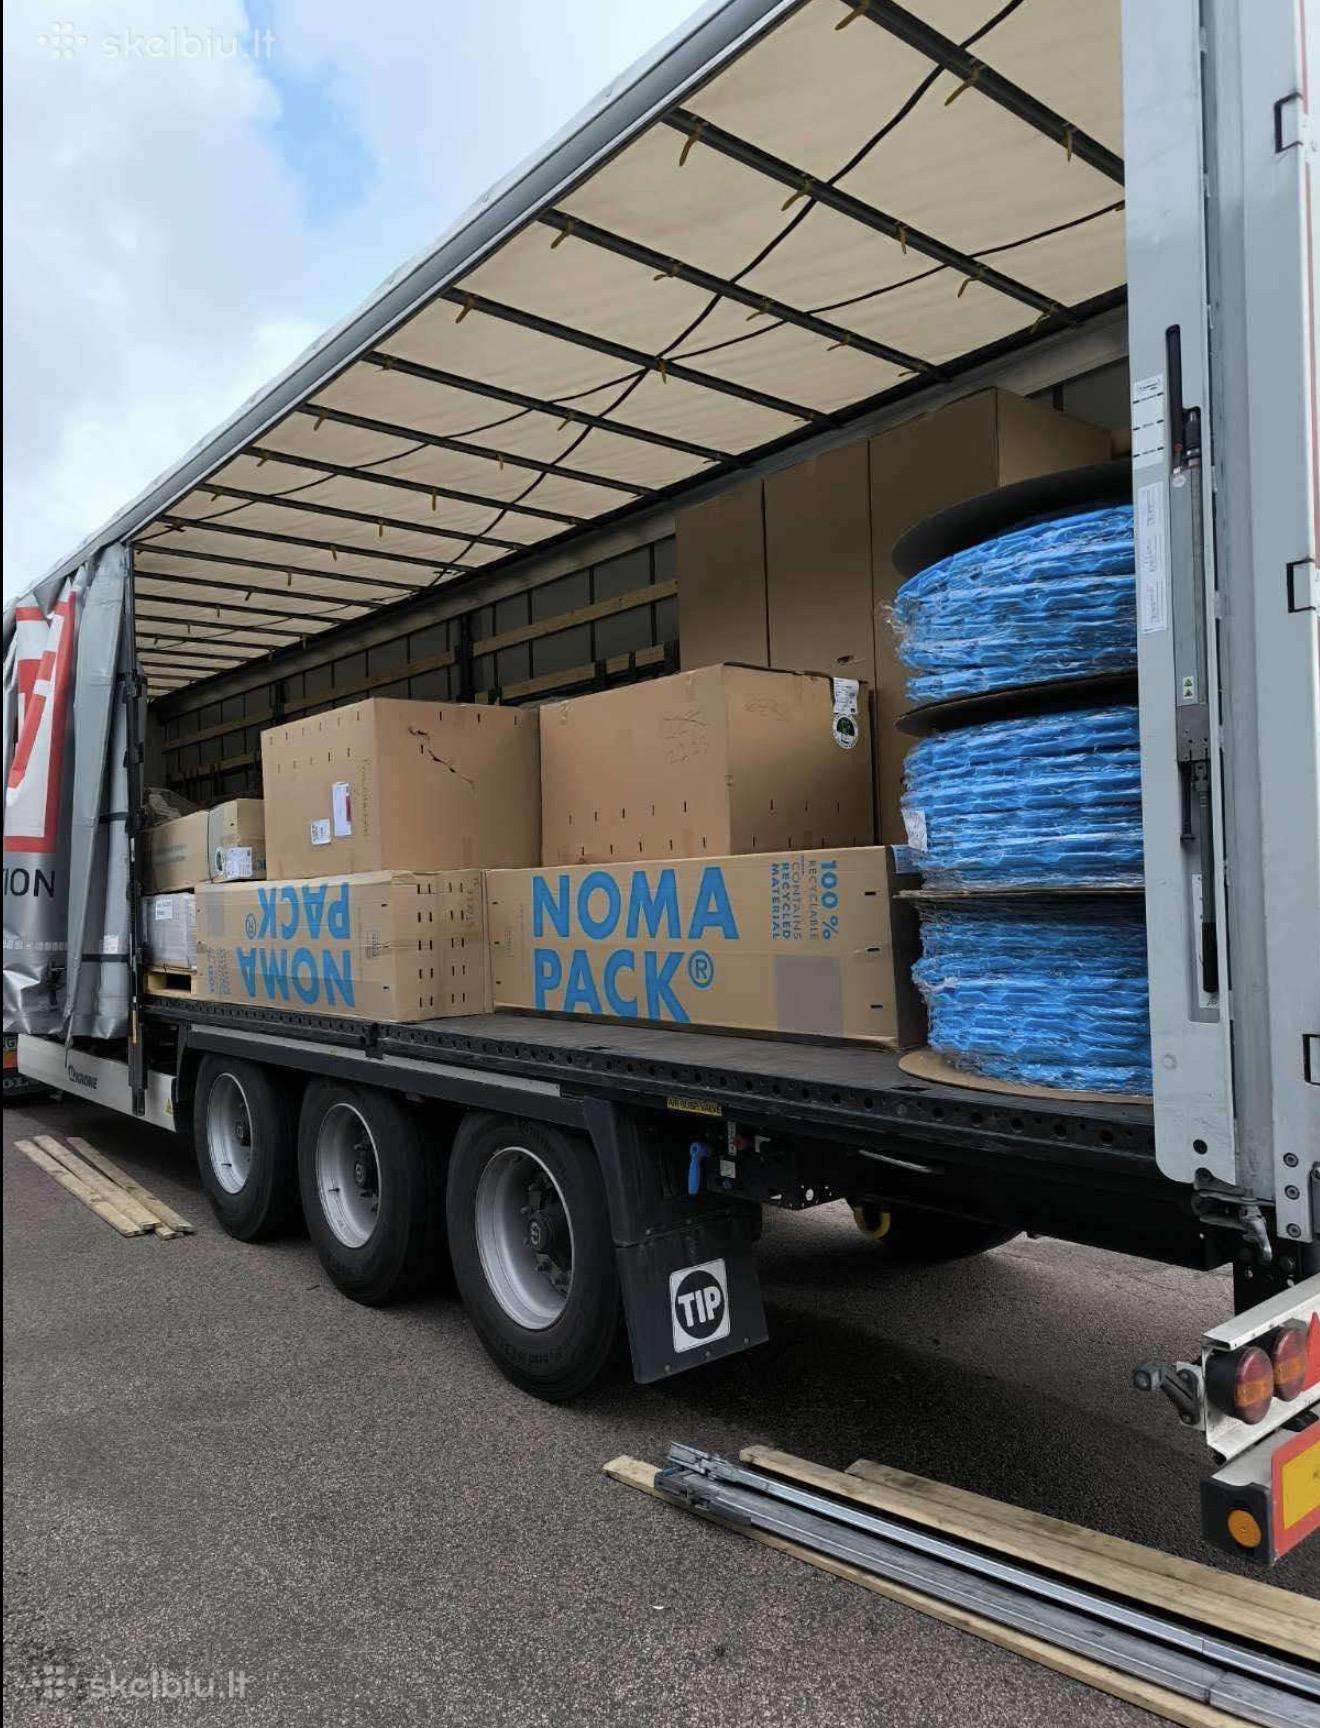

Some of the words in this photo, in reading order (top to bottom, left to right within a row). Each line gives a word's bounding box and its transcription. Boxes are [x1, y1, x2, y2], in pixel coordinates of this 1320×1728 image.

[532, 867, 739, 939] NOMA
[771, 863, 780, 940] MATERIAL
[782, 862, 790, 940] RECYCLED
[236, 947, 356, 1007] NOMA
[677, 1286, 721, 1327] TIP
